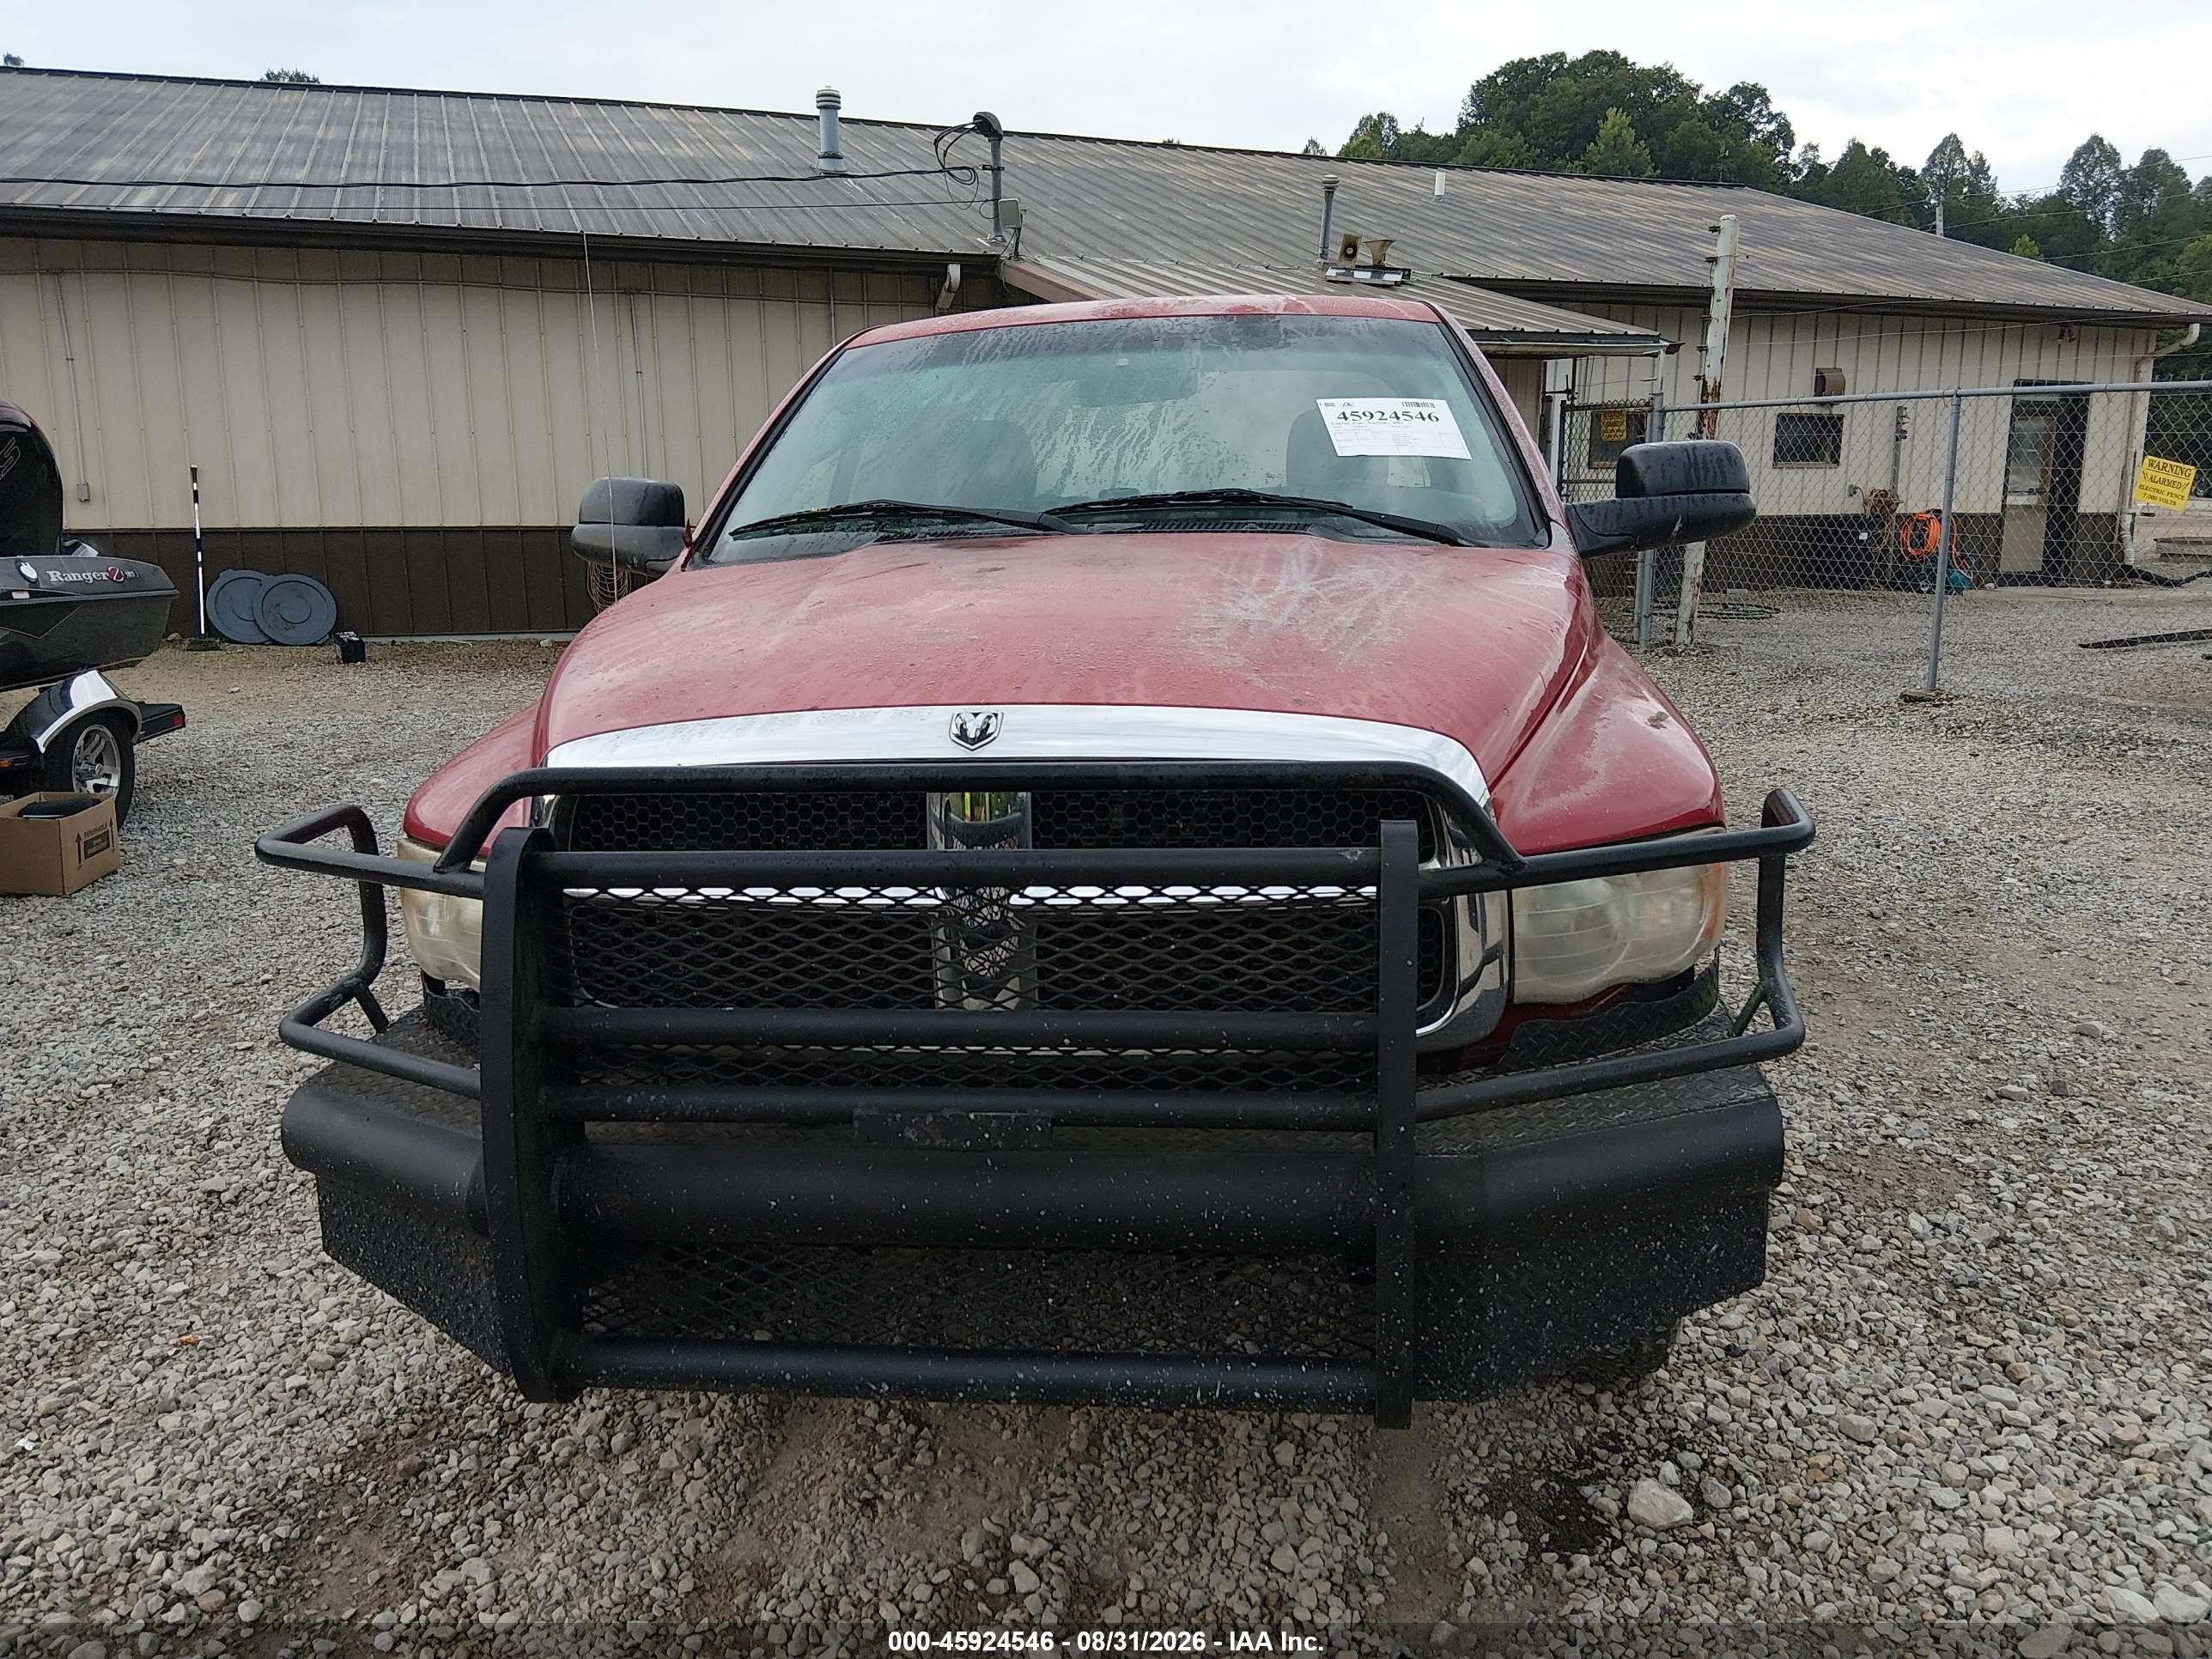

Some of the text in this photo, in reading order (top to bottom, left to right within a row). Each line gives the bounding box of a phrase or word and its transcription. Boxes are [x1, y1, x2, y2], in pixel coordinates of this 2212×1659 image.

[1337, 410, 1439, 422] 45924546
[2148, 459, 2191, 477] WARNING
[2138, 483, 2165, 495] ELECTRIC
[2148, 475, 2182, 489] ALARMED
[2142, 492, 2177, 506] 7,000 VOLTS
[46, 570, 109, 584] Ranger
